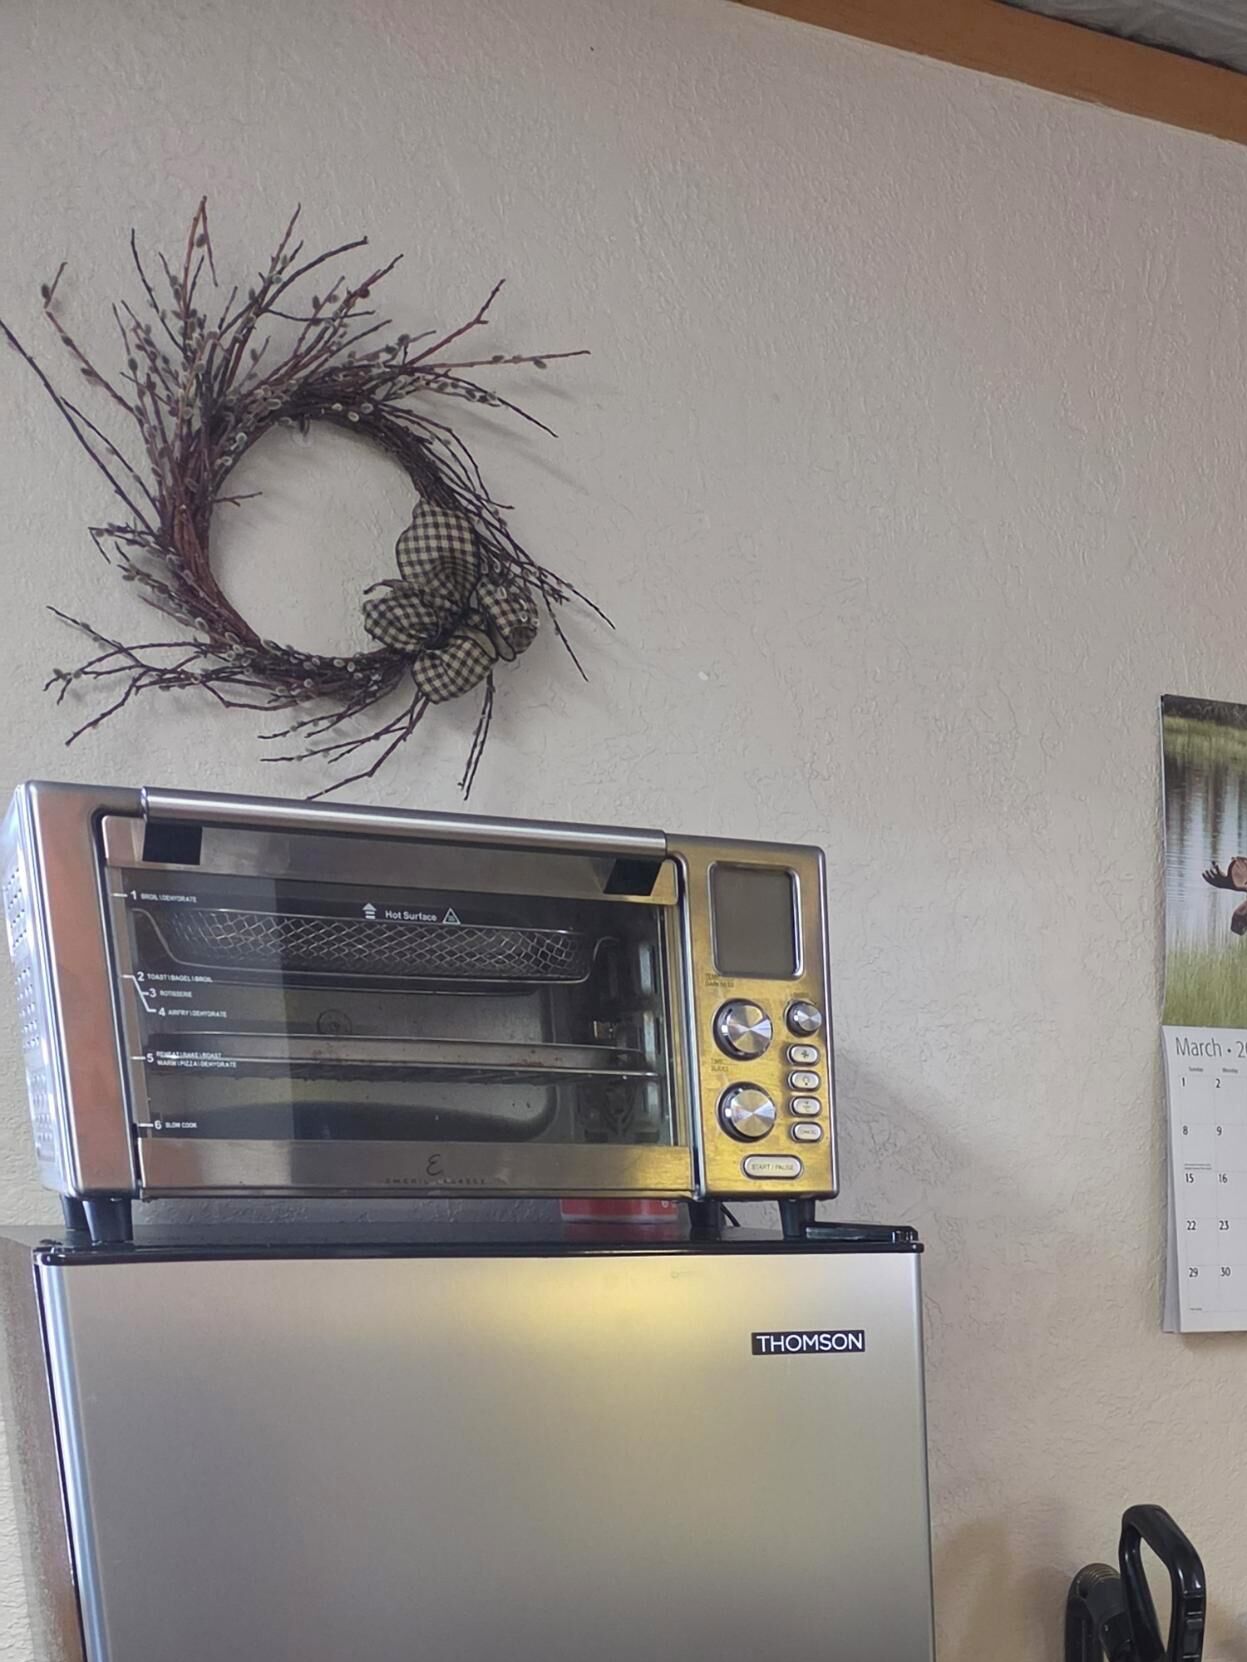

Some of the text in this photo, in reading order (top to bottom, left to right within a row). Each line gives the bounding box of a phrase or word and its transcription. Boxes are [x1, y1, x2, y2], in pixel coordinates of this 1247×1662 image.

[130, 890, 137, 900] 1
[385, 910, 437, 921] Hot Surface
[137, 972, 144, 981] 2
[148, 988, 157, 998] 3
[158, 1008, 166, 1016] 4
[1176, 1037, 1221, 1056] March
[147, 1053, 154, 1063] 5
[1181, 1076, 1186, 1087] 1
[1215, 1078, 1221, 1089] 2
[154, 1120, 162, 1129] 6
[1182, 1125, 1189, 1136] 8
[1216, 1126, 1223, 1136] 9
[1185, 1172, 1195, 1184] 15
[1218, 1173, 1228, 1184] 16
[1186, 1220, 1197, 1231] 22
[1219, 1219, 1230, 1231] 23
[1188, 1267, 1199, 1278] 29
[1220, 1266, 1231, 1277] 30
[756, 1333, 862, 1352] THOMSON
